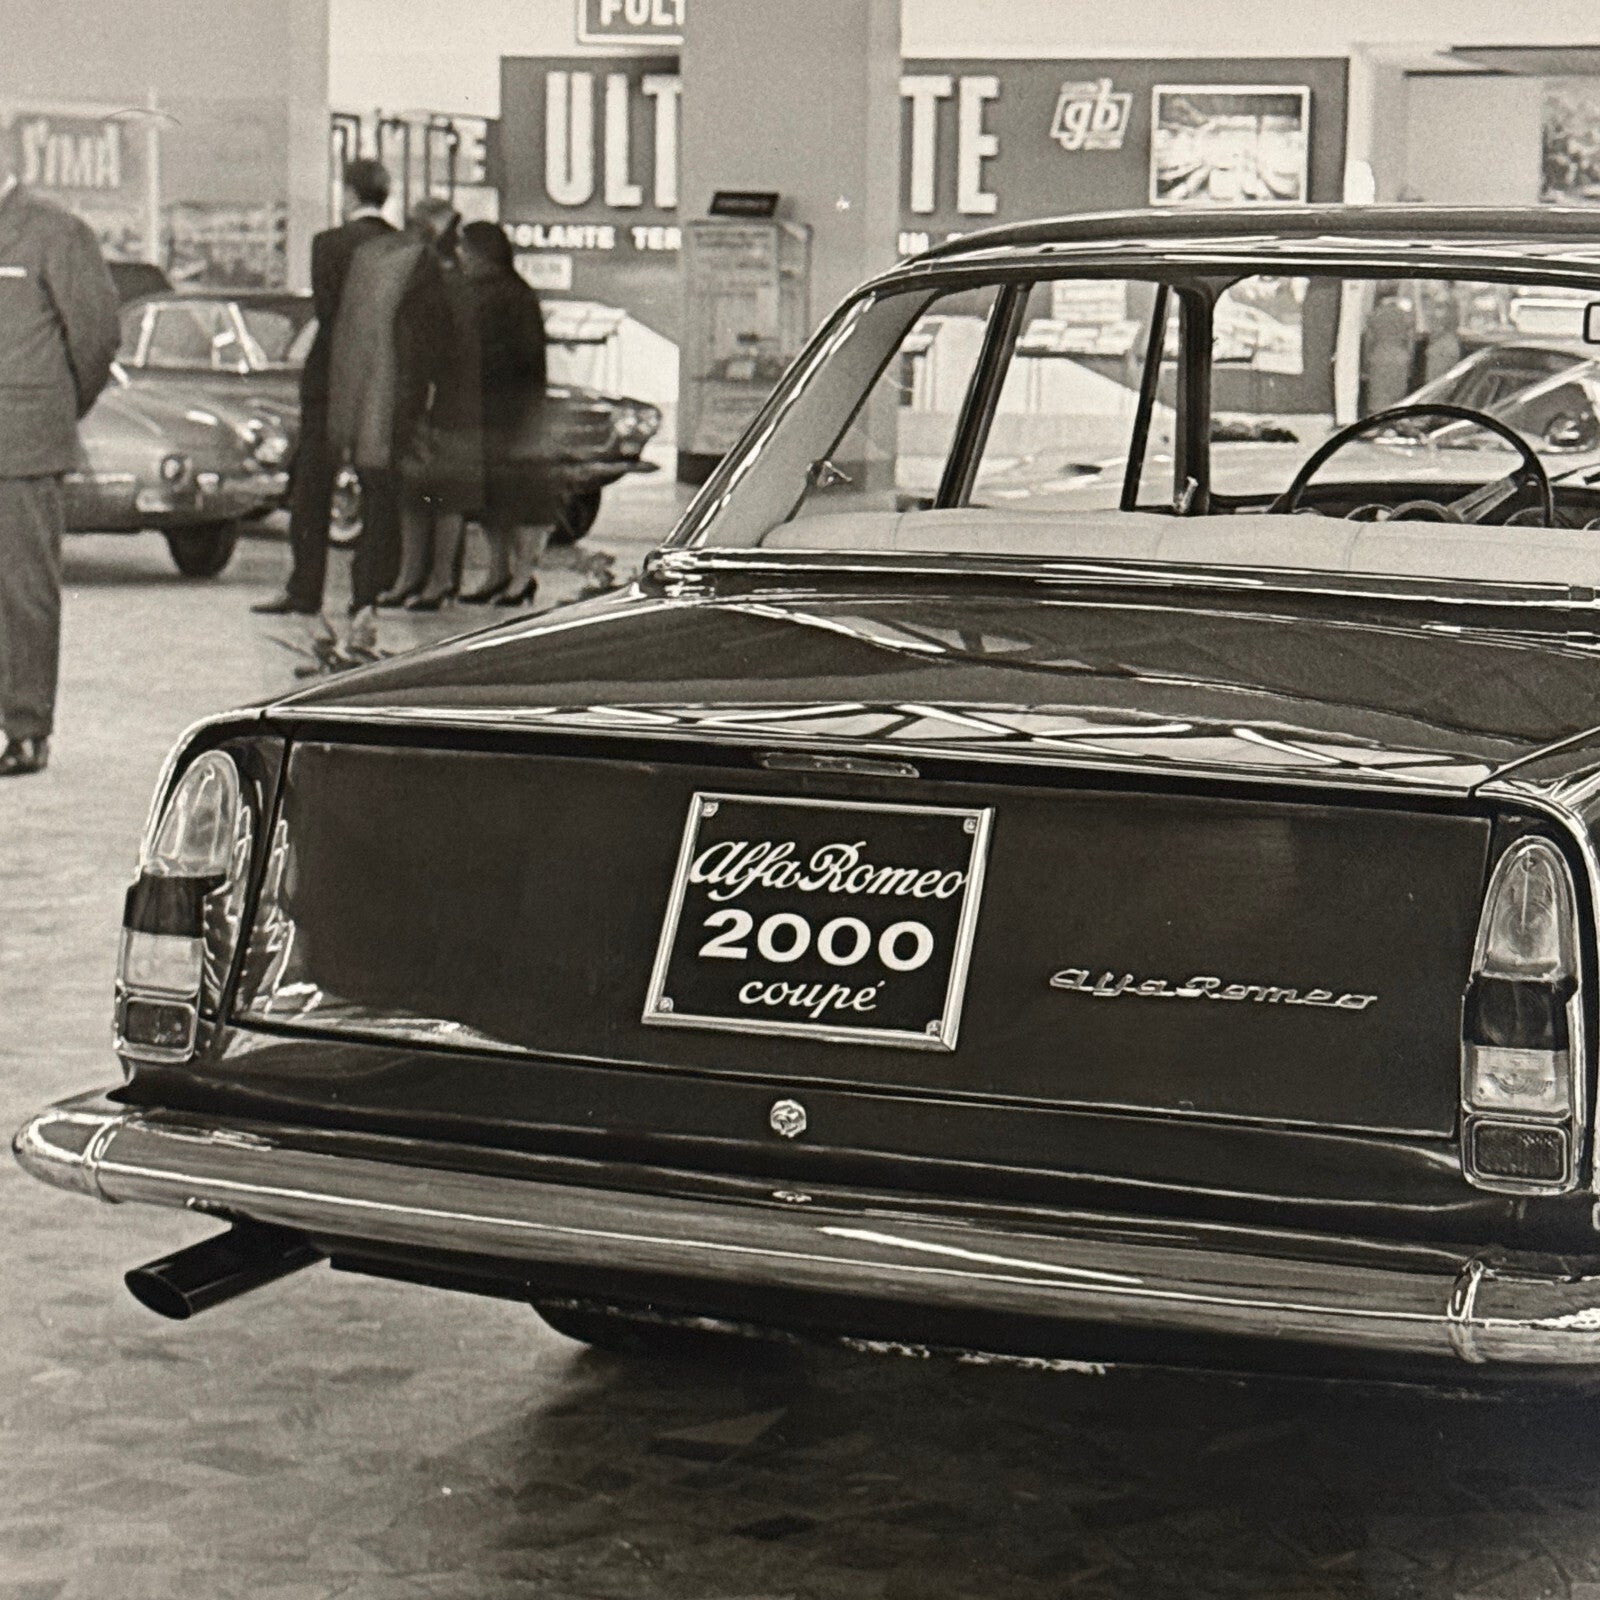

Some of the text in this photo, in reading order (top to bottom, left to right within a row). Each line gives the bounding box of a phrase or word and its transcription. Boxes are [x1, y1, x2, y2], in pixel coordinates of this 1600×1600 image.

[688, 840, 969, 901] Alfa Romeo
[698, 908, 934, 972] 2000
[738, 980, 886, 1019] coupé
[1050, 968, 1378, 1010] Alfa Romeo
